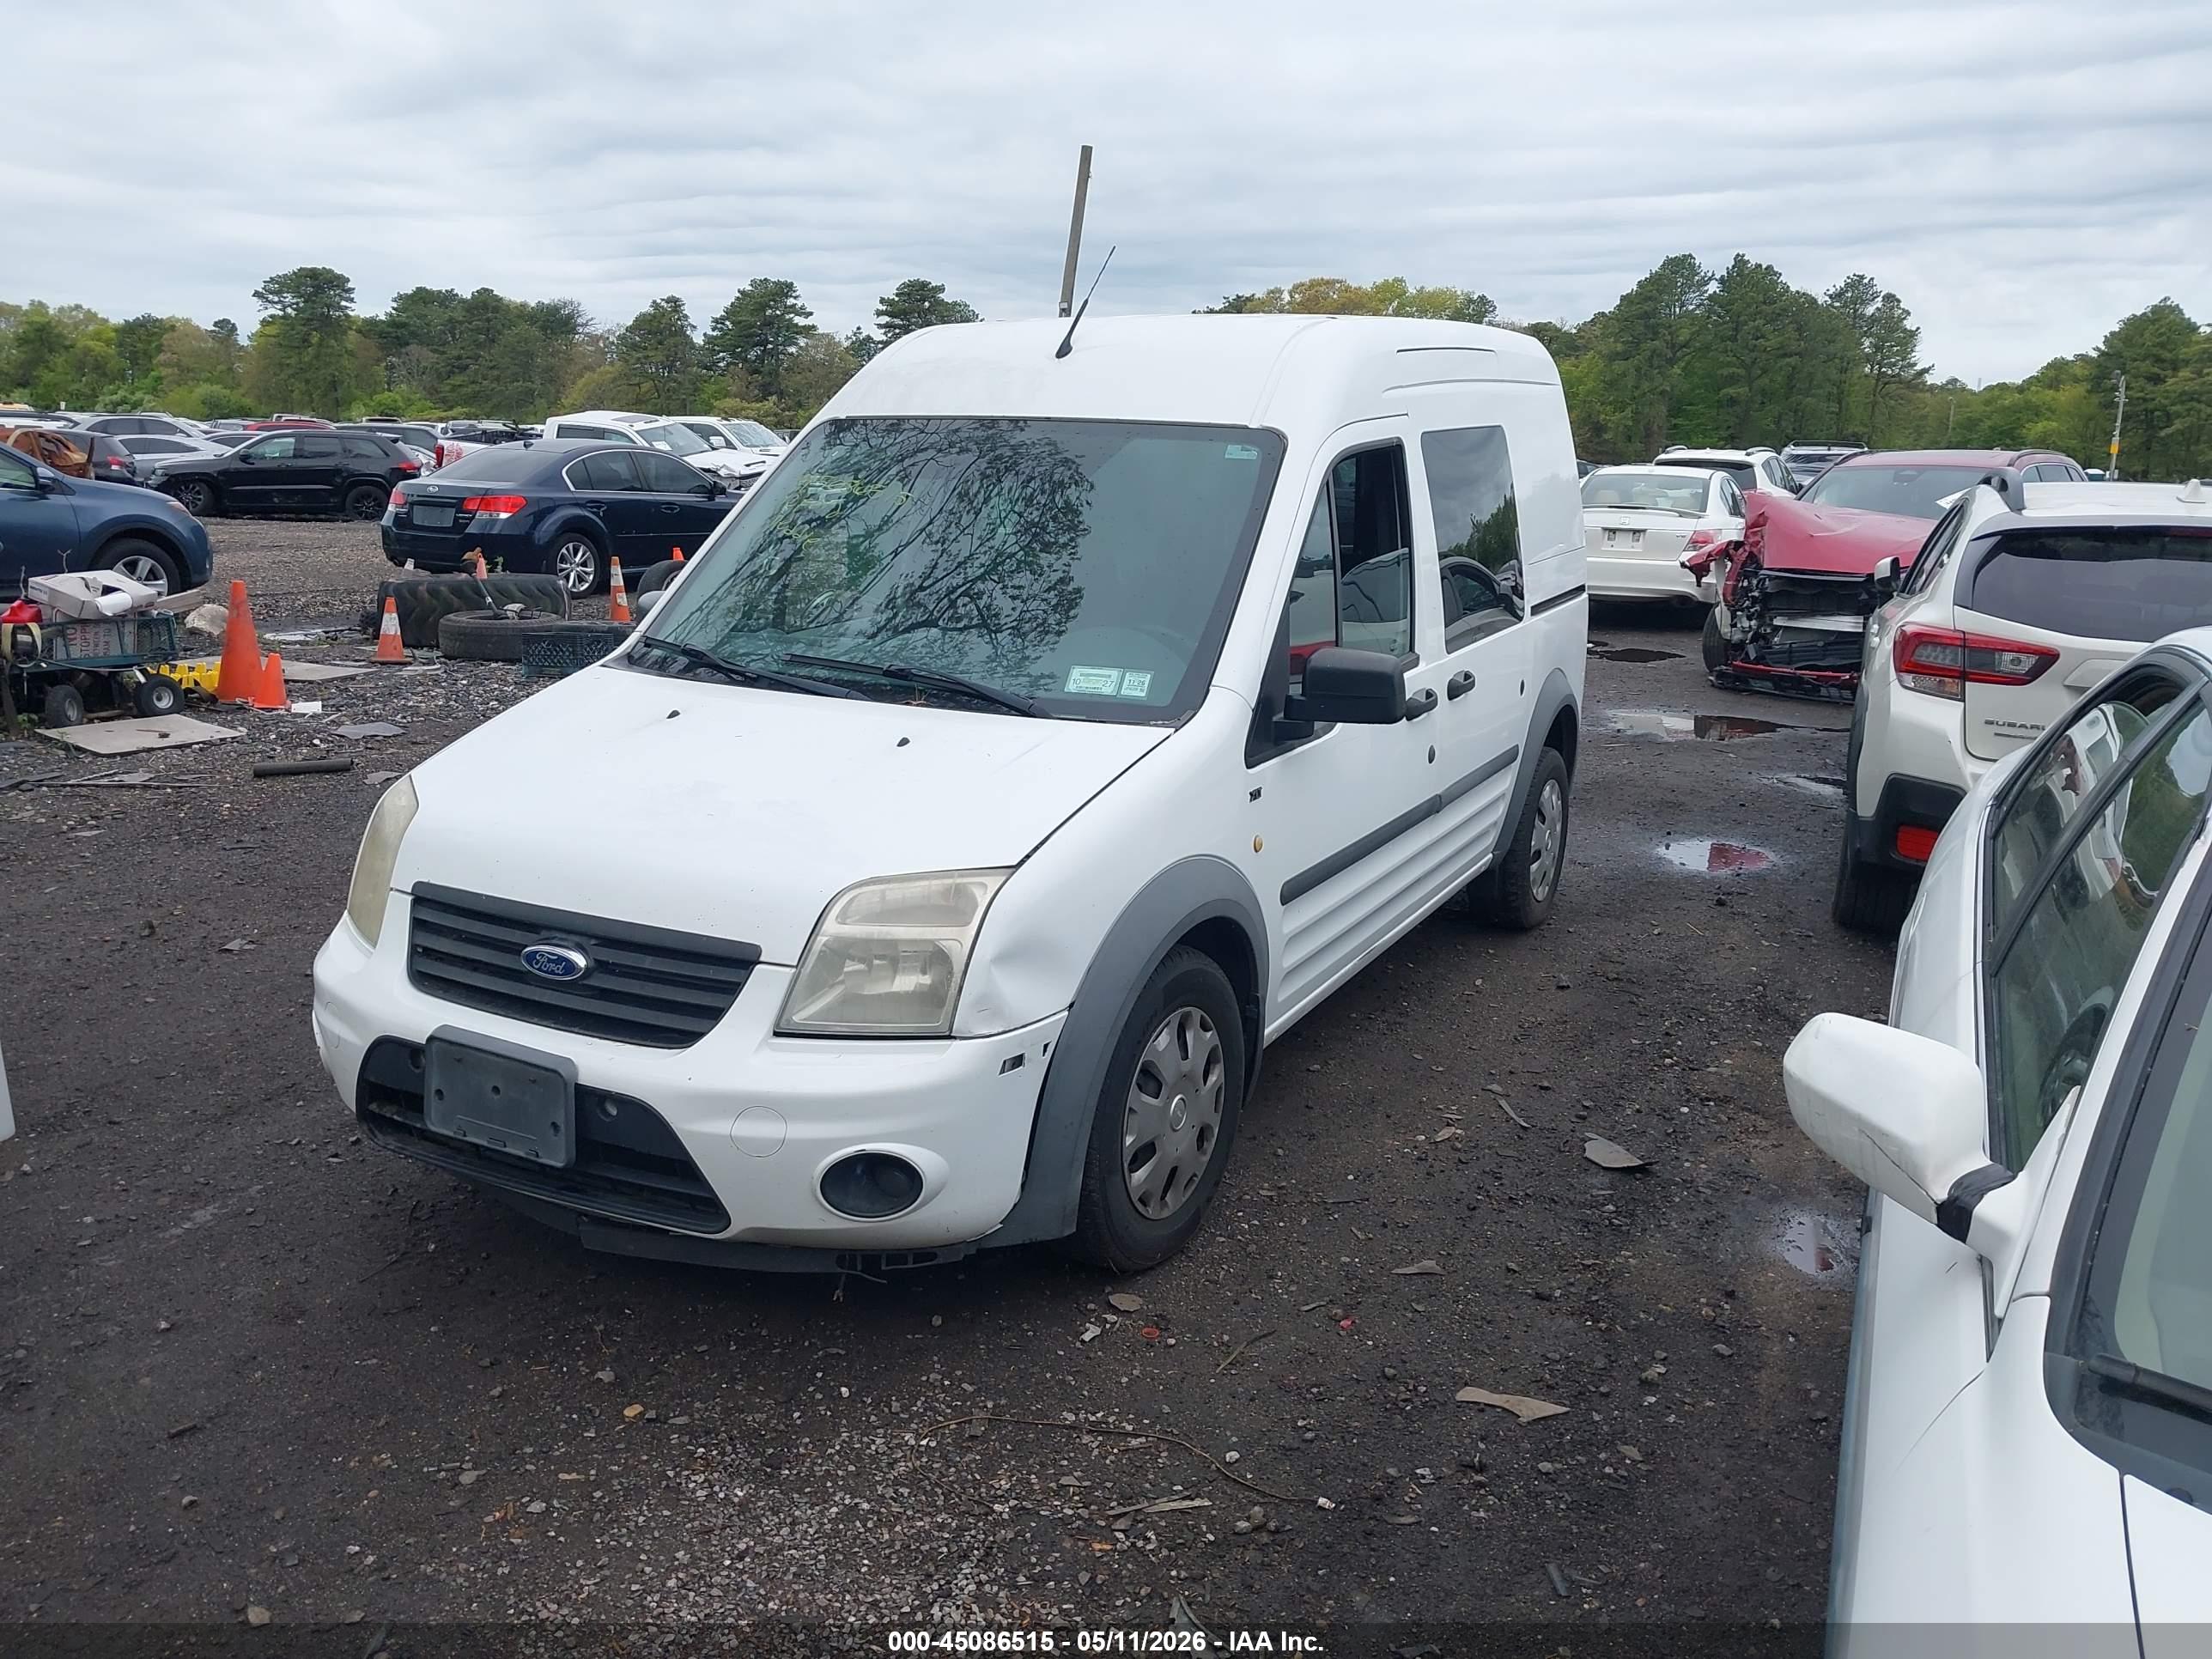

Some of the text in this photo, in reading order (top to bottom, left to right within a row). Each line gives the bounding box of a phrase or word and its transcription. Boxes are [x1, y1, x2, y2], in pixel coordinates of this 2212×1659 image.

[80, 624, 90, 659] STOPPI
[1102, 679, 1115, 688] 27
[532, 951, 567, 975] Ford
